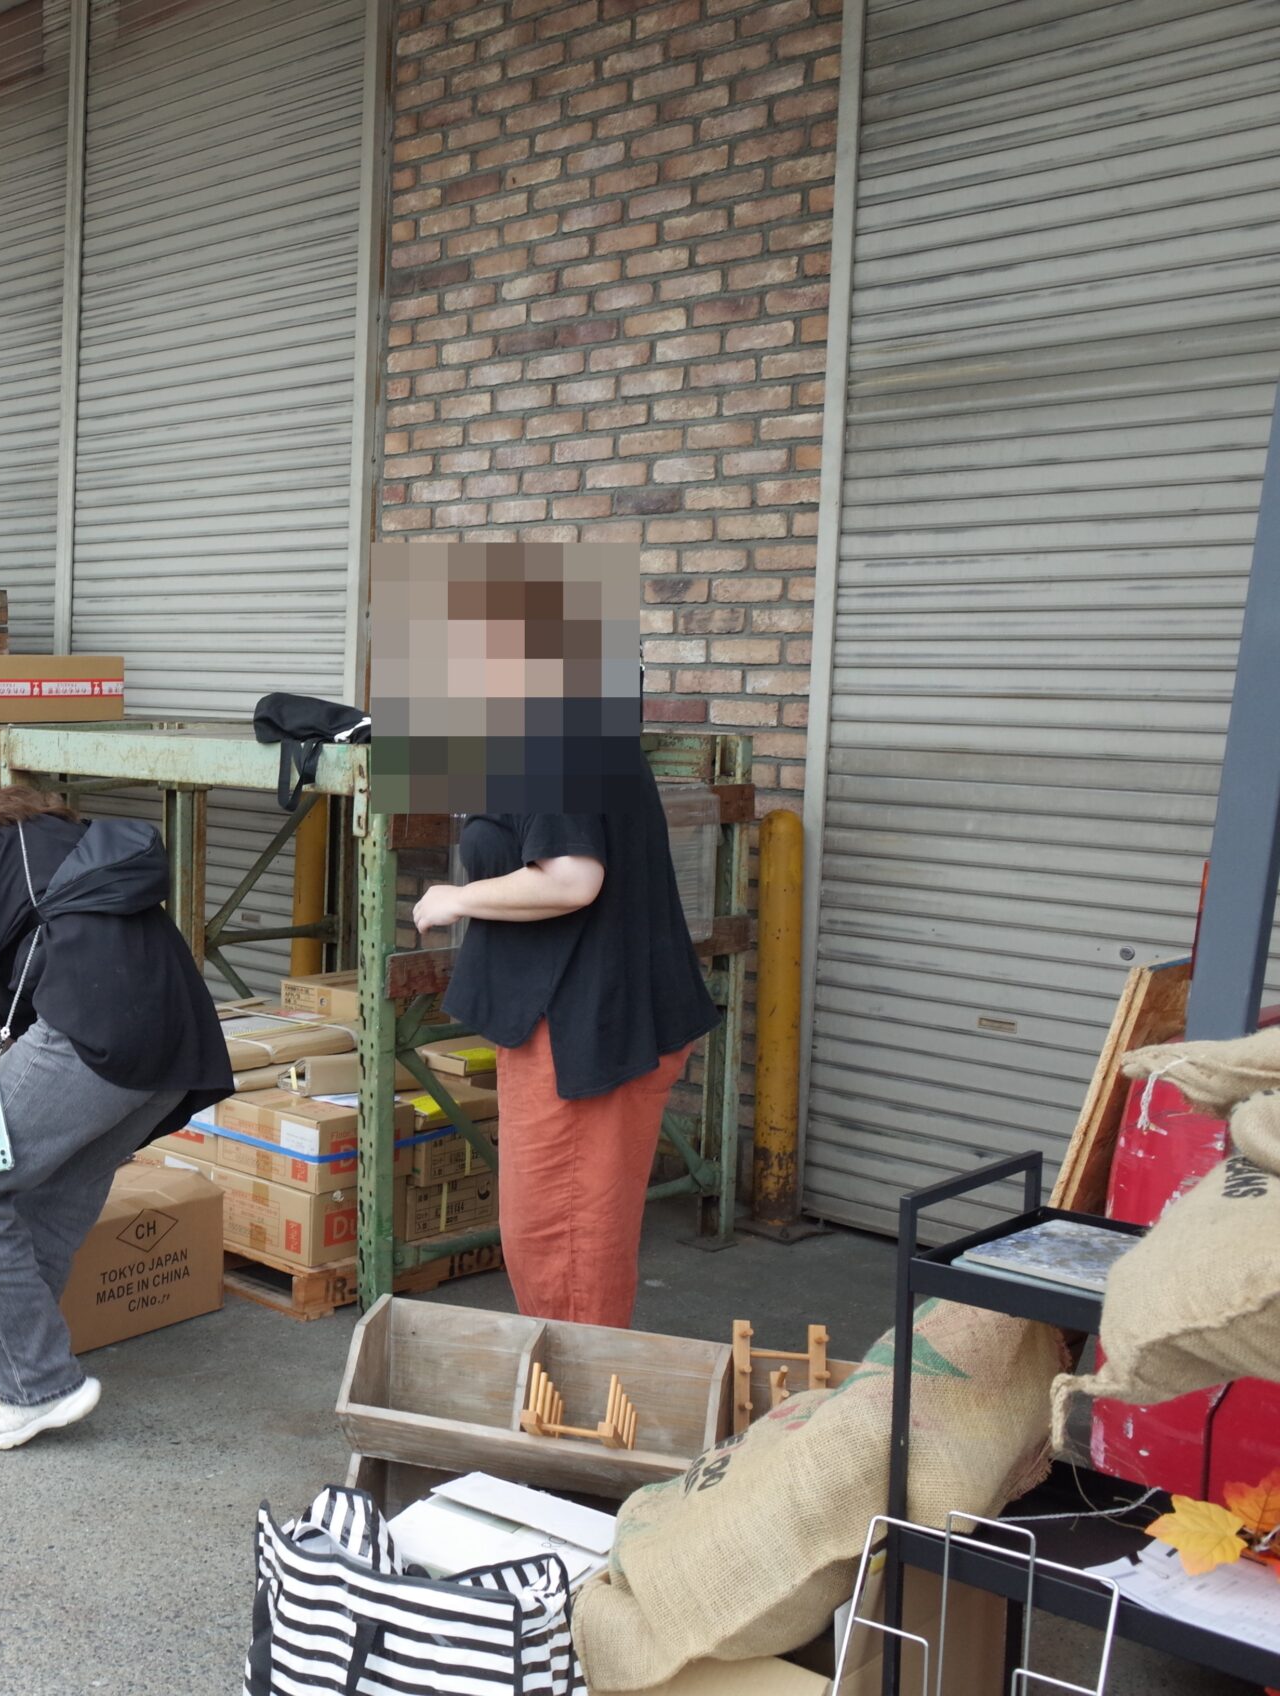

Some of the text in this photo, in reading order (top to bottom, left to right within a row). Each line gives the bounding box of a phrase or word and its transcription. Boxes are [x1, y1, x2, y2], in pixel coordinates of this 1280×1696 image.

[135, 1219, 157, 1240] CH
[100, 1248, 189, 1285] TOKYO JAPAN
[95, 1282, 134, 1306] MADE
[137, 1278, 149, 1292] IN
[152, 1265, 191, 1288] CHINA
